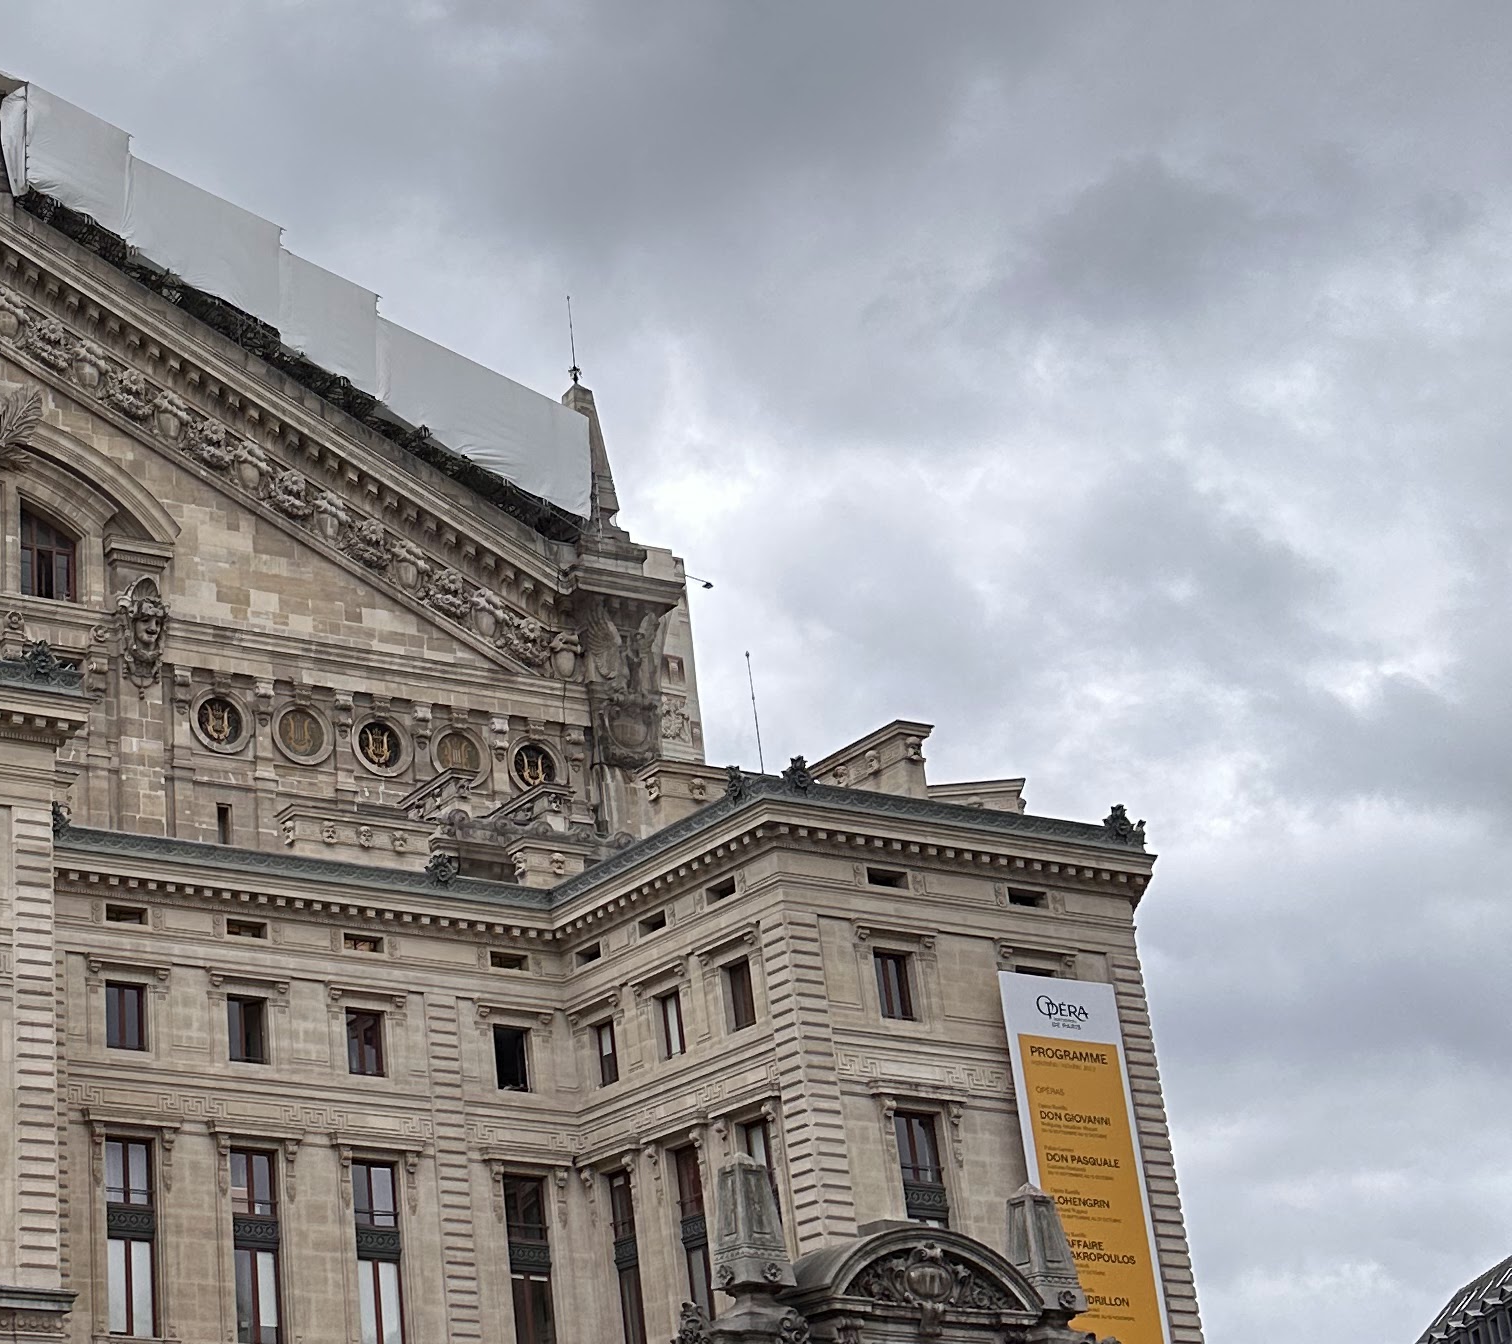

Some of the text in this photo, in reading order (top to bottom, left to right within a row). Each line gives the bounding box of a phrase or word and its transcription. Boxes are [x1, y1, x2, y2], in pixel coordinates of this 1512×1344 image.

[1030, 1045, 1109, 1065] PROGRAMME
[1039, 1110, 1111, 1126] DON GIOVANNI
[1046, 1152, 1068, 1164] DON
[1070, 1154, 1120, 1169] PASQUALE
